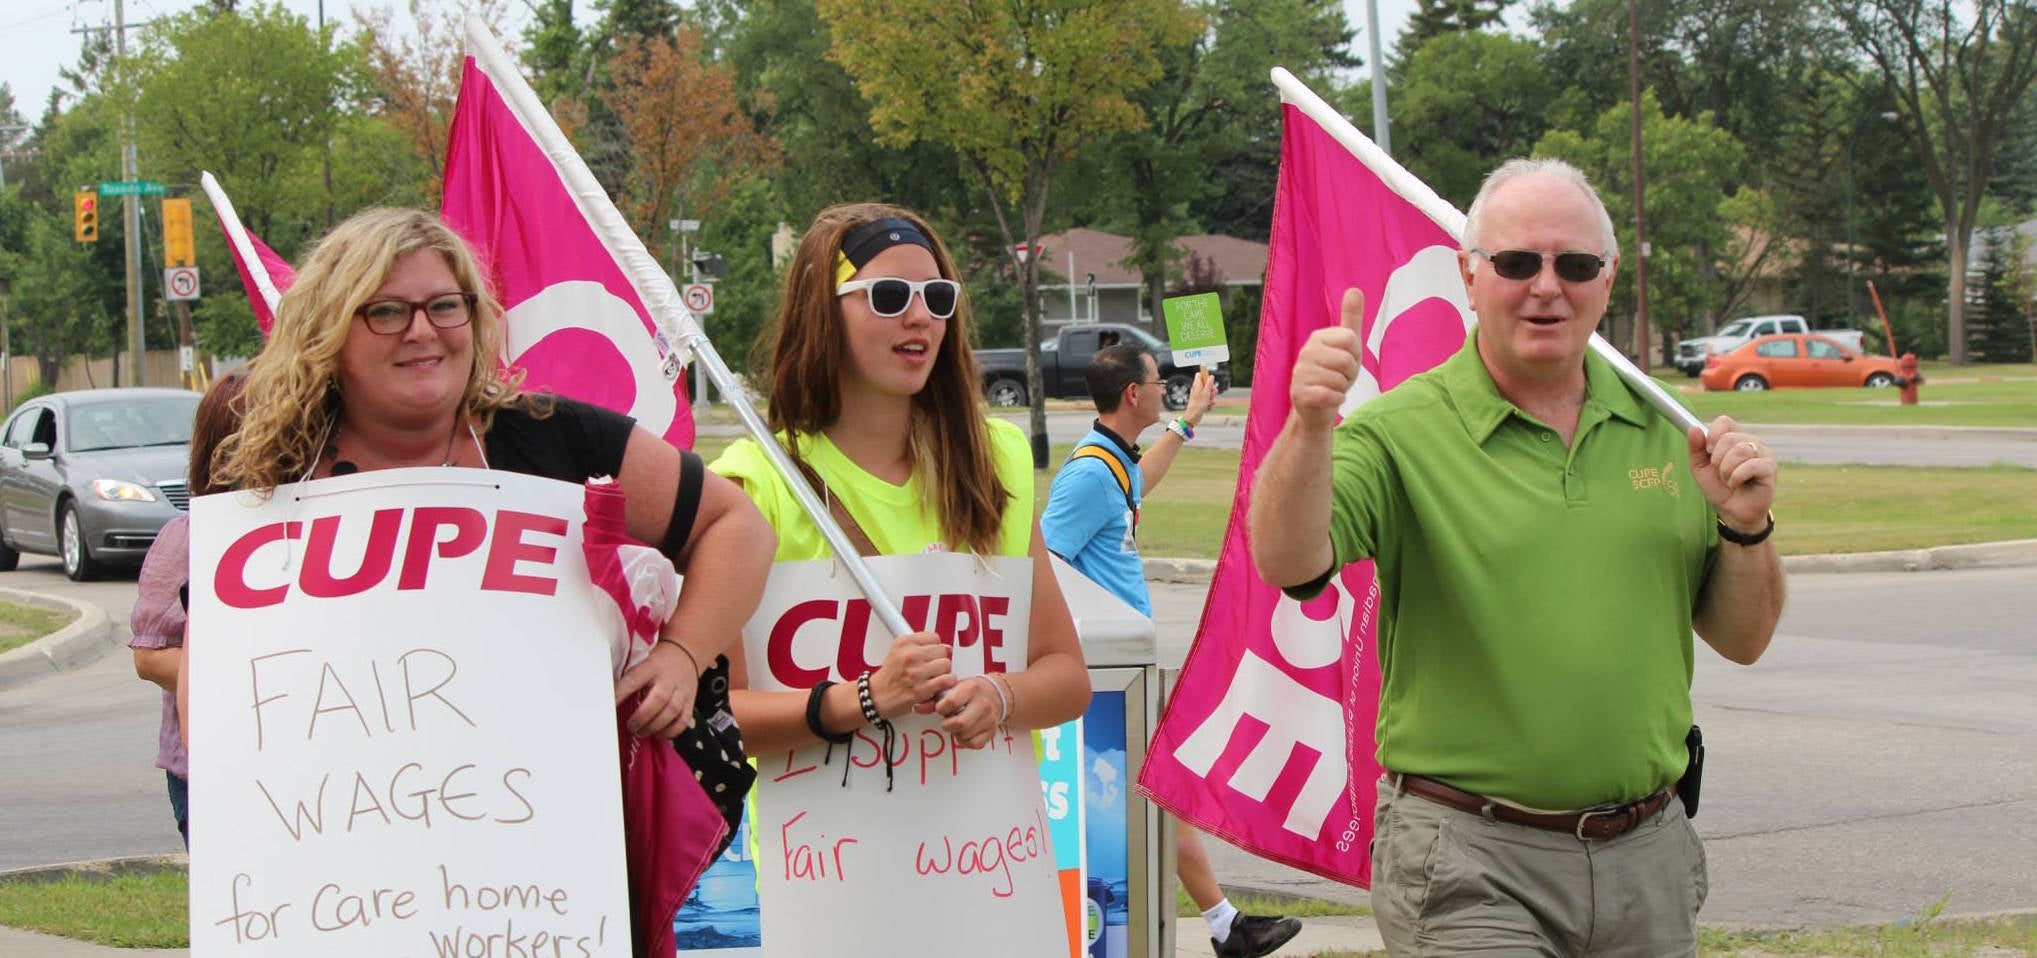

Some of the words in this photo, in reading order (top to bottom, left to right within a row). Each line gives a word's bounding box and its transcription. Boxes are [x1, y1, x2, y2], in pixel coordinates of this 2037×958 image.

[1175, 299, 1190, 311] FOR
[1191, 296, 1209, 309] THE
[1180, 320, 1195, 331] WE
[1196, 318, 1209, 329] ALL
[1180, 327, 1215, 342] DESERVE
[1628, 467, 1658, 479] CUPE
[213, 506, 569, 609] CUPE
[250, 648, 477, 751] FAIR
[255, 762, 535, 842] WAGES
[782, 811, 859, 881] Fair
[215, 873, 293, 943] for
[439, 864, 568, 915] home
